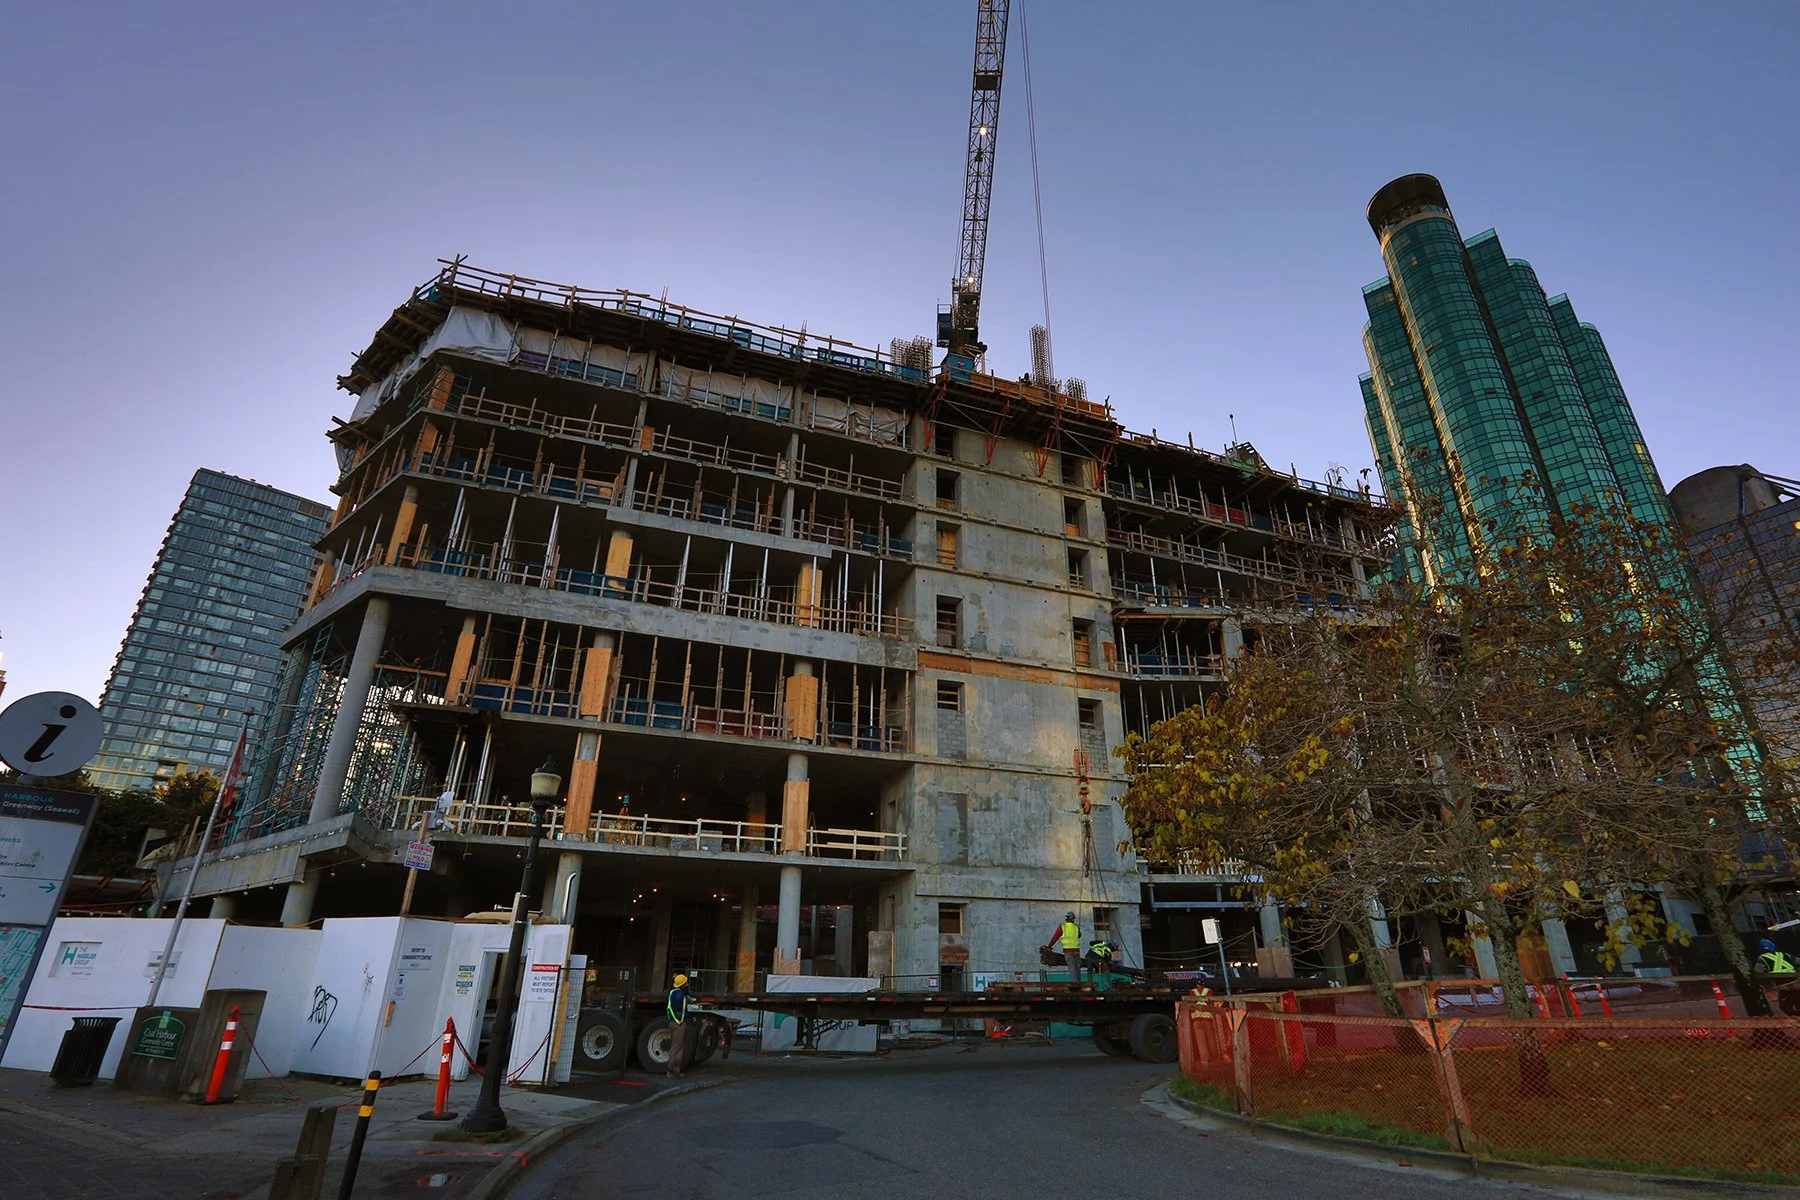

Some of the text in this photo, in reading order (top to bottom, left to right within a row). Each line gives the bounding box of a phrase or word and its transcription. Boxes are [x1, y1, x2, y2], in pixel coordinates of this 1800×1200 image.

[4, 792, 56, 803] HARBOUR
[2, 801, 81, 816] Greenway (Seawall)
[143, 1028, 177, 1040] Coal Harbour
